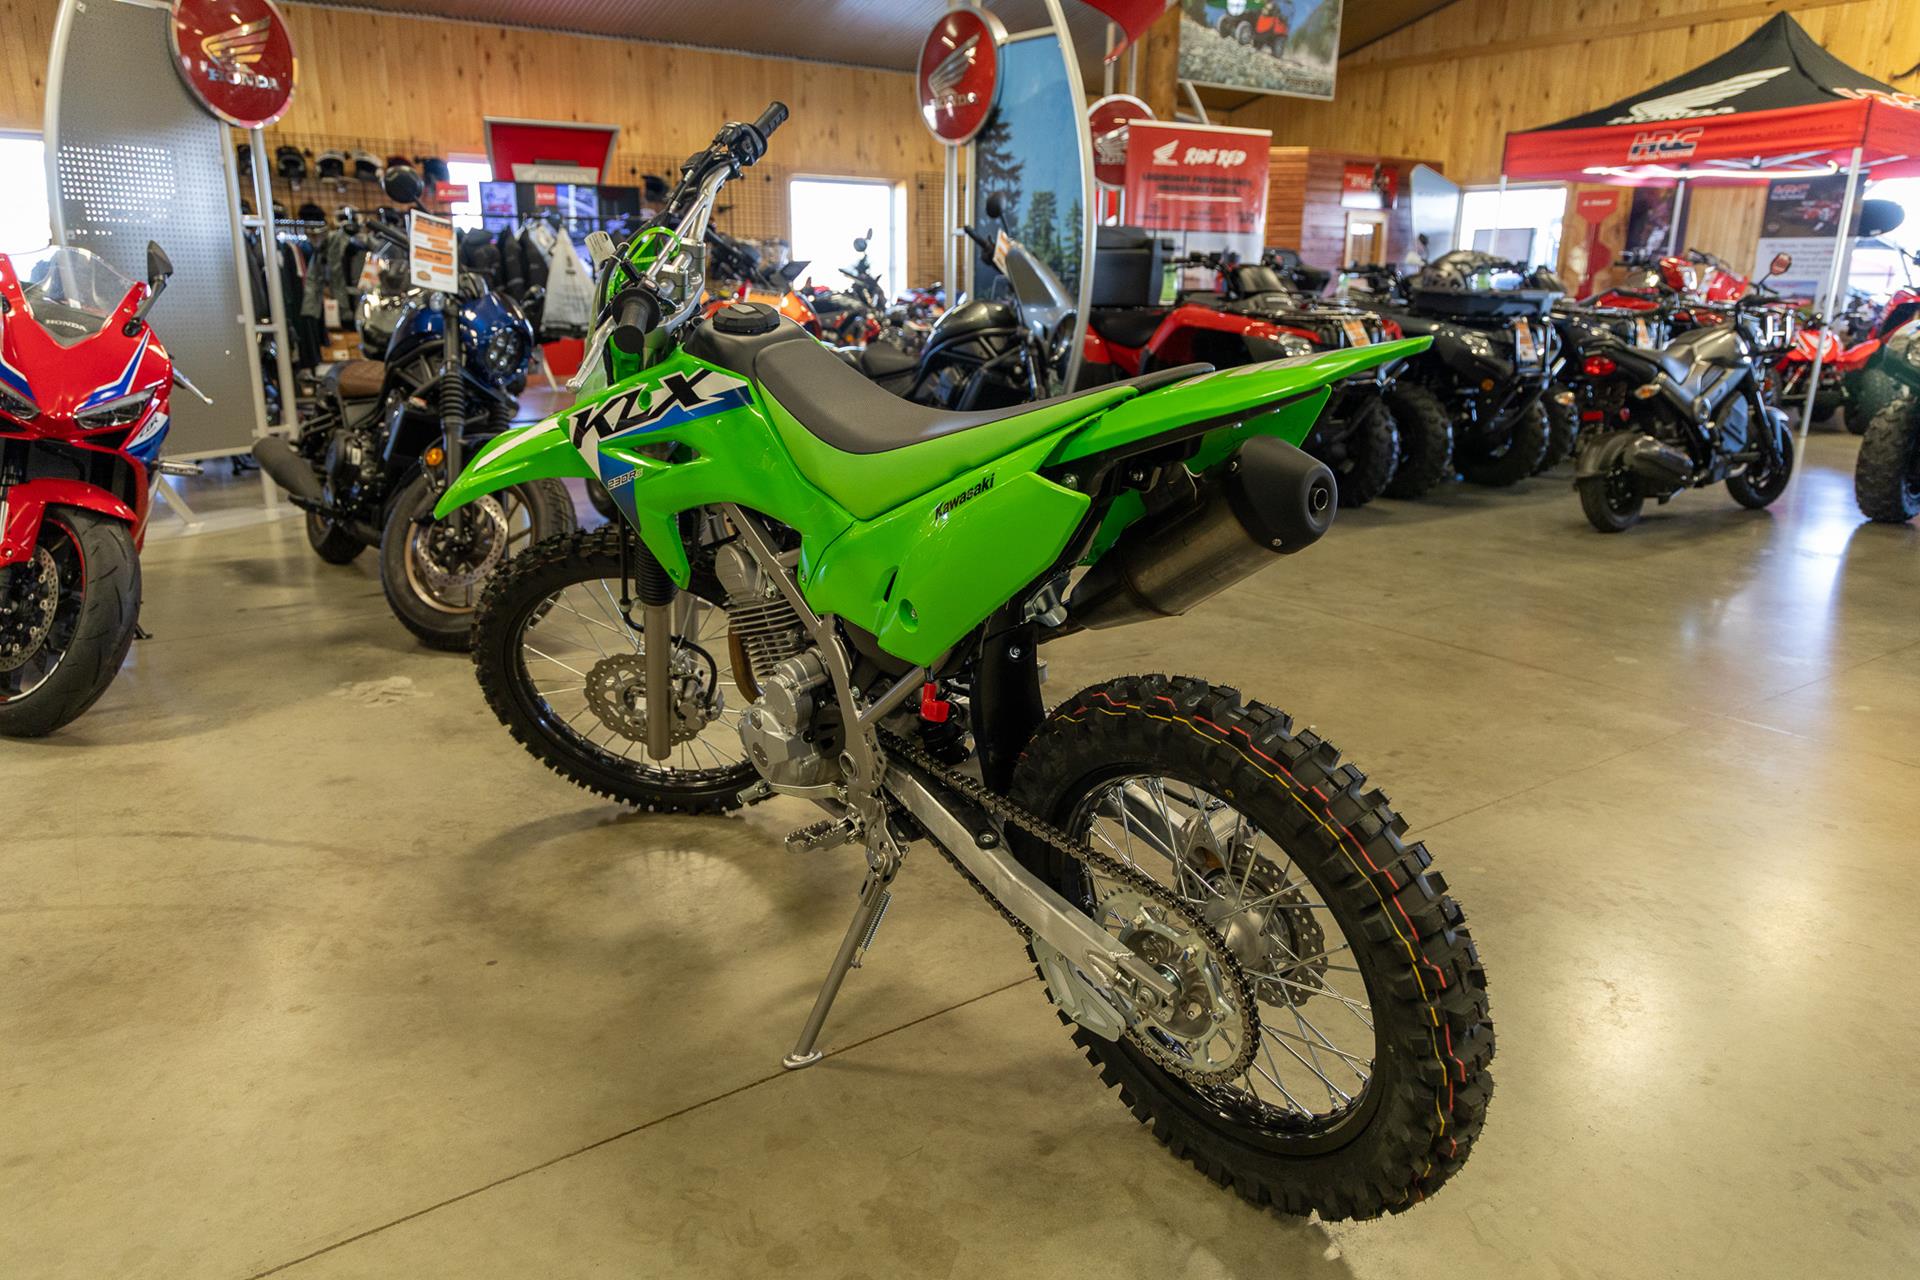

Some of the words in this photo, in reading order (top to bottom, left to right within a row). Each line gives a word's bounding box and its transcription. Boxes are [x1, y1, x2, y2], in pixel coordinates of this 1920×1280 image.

[208, 68, 279, 91] HONDA
[1184, 147, 1218, 165] RIDE
[45, 319, 88, 332] HONDA
[572, 368, 713, 449] KLX
[934, 472, 996, 520] Kawasaki
